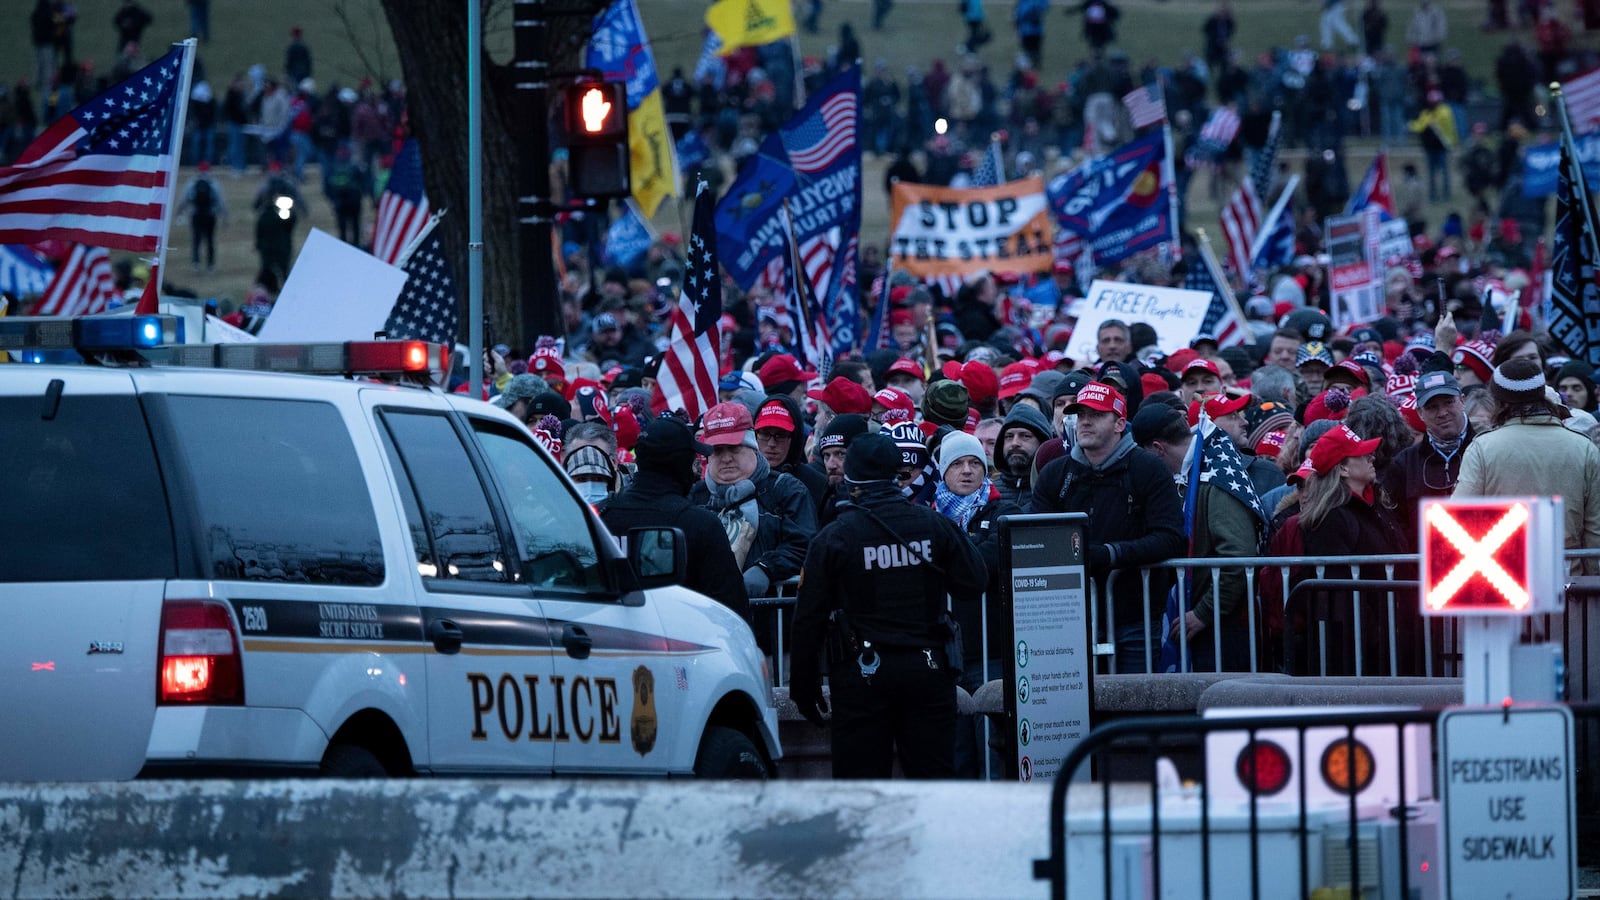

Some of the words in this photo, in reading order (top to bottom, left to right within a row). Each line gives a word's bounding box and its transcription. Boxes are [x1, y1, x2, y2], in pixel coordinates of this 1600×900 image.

[920, 196, 1017, 230] STOP
[898, 237, 946, 262] THE
[958, 230, 1050, 261] STEAL
[1094, 289, 1143, 314] FREE
[902, 451, 918, 464] 20
[864, 540, 932, 570] POLICE
[1014, 579, 1034, 588] COVID-19
[1034, 578, 1048, 588] Safety
[242, 606, 268, 631] 2520
[318, 604, 348, 620] UNITED
[350, 605, 378, 620] STATES
[319, 622, 349, 638] SECRET
[350, 623, 384, 638] SERVICE
[466, 672, 620, 744] POLICE
[1452, 757, 1562, 782] PEDESTRIANS
[1489, 796, 1526, 822] USE
[1462, 836, 1555, 861] SIDEWALK
